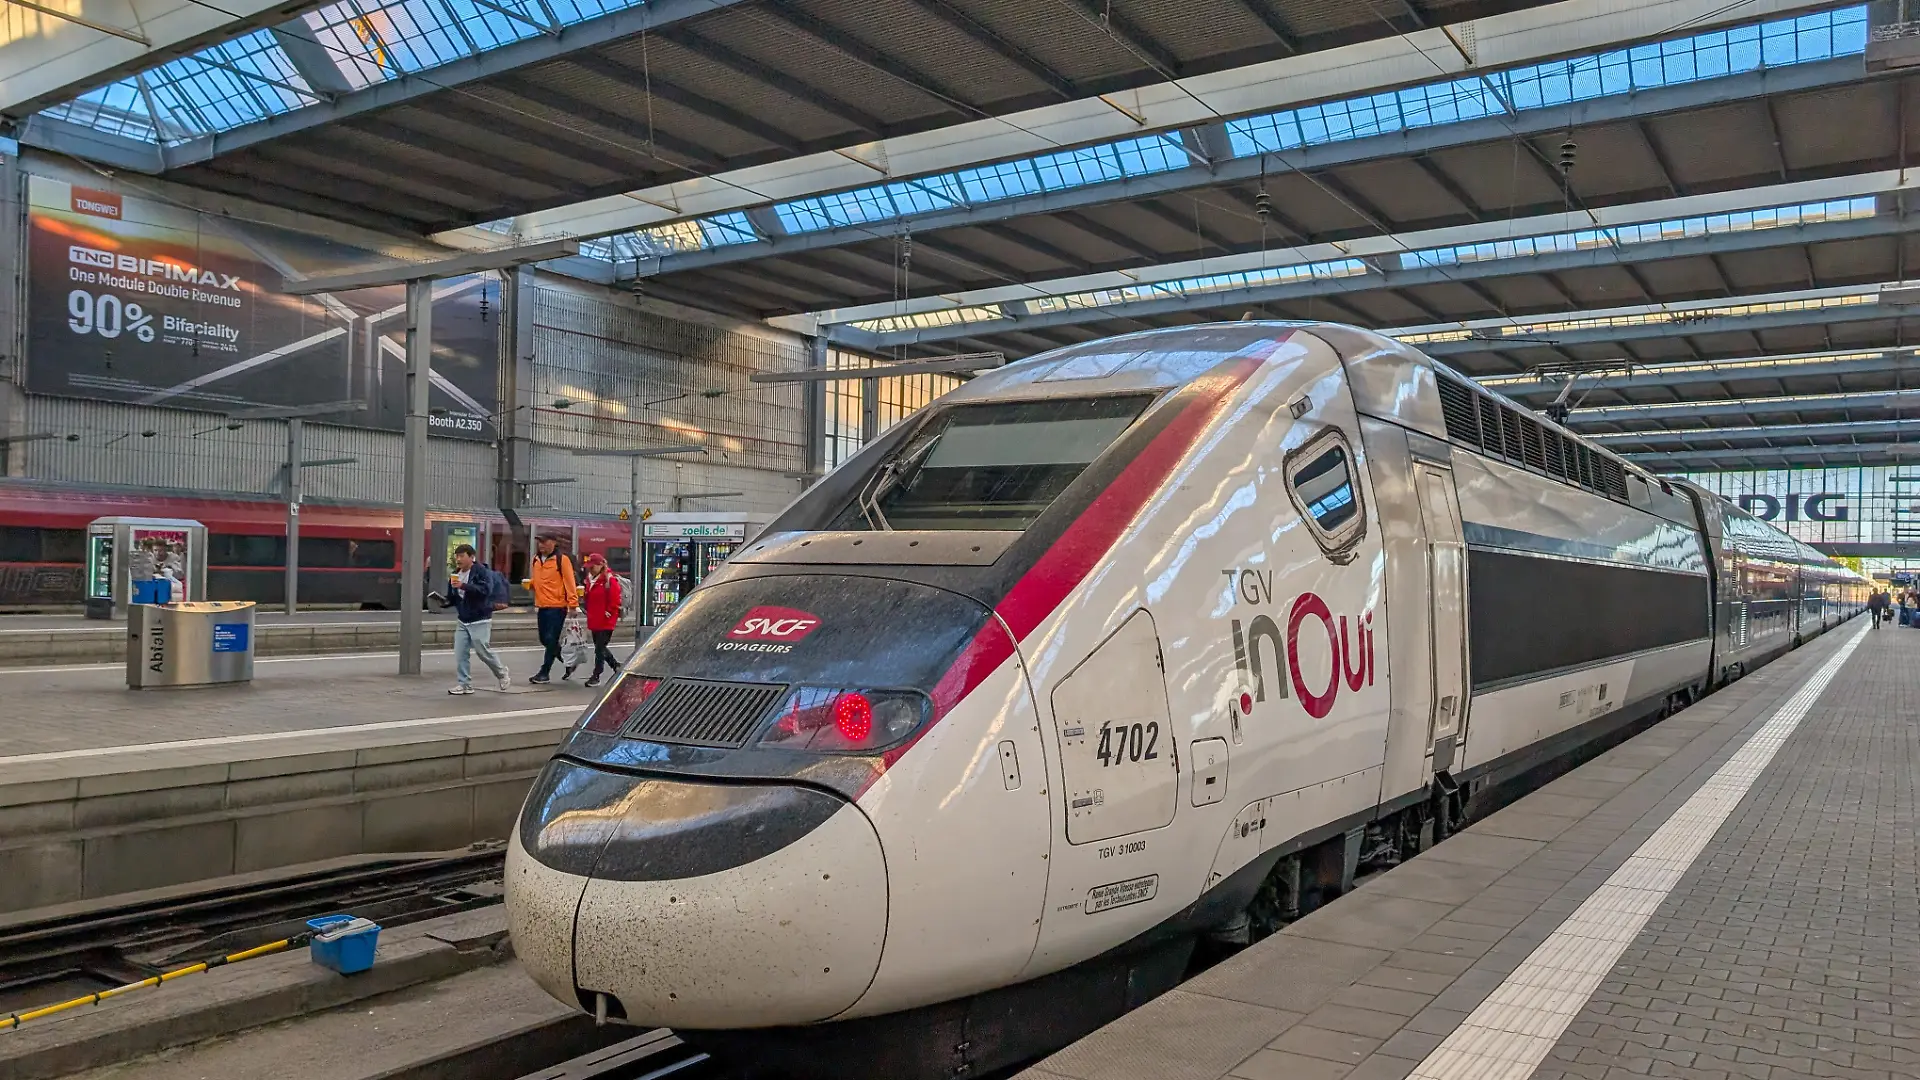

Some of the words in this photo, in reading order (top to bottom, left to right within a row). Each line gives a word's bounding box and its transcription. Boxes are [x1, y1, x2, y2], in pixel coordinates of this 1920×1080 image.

[76, 198, 118, 216] TONGWEI
[72, 249, 112, 265] TNC
[117, 254, 241, 291] BIFIMAX
[69, 267, 95, 283] One
[99, 271, 145, 292] Module
[148, 280, 189, 299] Double
[192, 288, 241, 308] Revenue
[68, 289, 155, 343] 90%
[163, 315, 239, 343] Bifaciality
[429, 414, 454, 428] Booth
[455, 418, 482, 431] A2.350
[1719, 494, 1848, 521] DIG
[682, 525, 726, 535] zoells.de
[1222, 569, 1272, 605] TGV
[733, 618, 817, 636] SNCF
[715, 642, 792, 654] VOYAGEURS
[1096, 720, 1159, 767] 4702
[1098, 845, 1116, 860] TGV
[1118, 840, 1146, 856] 310003
